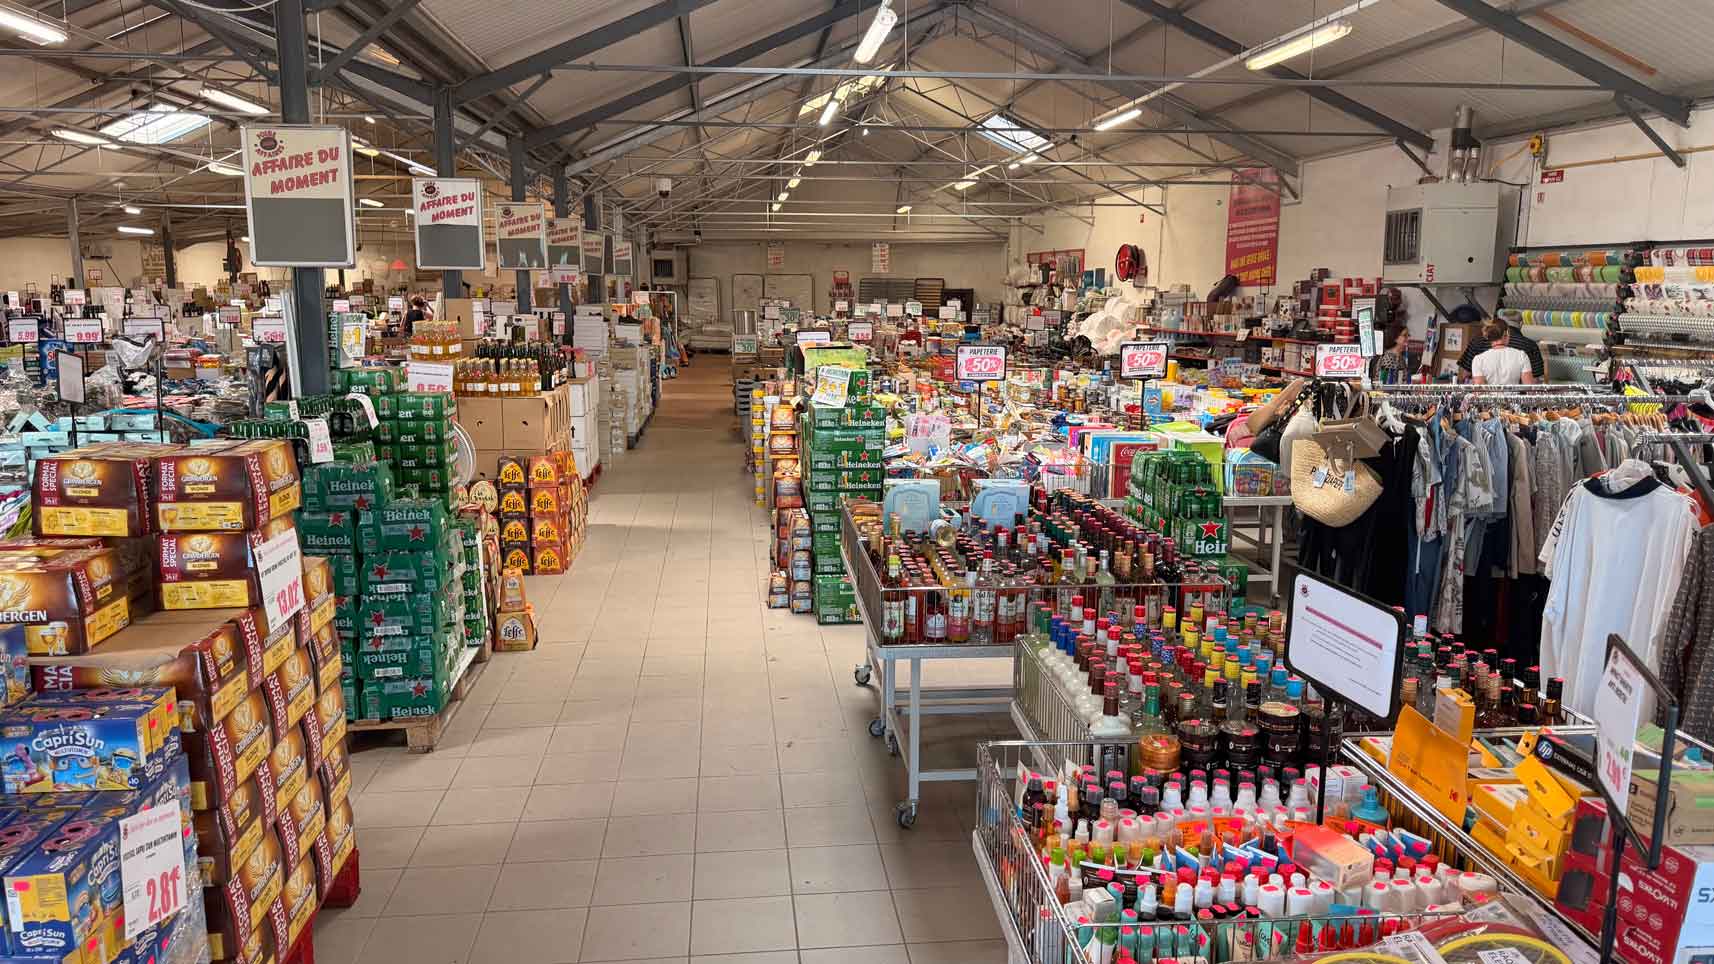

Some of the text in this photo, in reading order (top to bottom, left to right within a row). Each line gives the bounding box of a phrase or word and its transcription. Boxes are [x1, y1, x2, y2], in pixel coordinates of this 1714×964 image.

[252, 147, 339, 176] AFFAIRE DU
[271, 169, 338, 194] MOMENT
[420, 192, 475, 212] AFFAIRE DU
[432, 206, 474, 222] MOMENT
[500, 216, 529, 229] AFFAIRE
[1425, 264, 1436, 283] CIAT
[504, 466, 521, 480] Leffe
[535, 466, 553, 480] Leffe
[330, 480, 375, 491] Heinek
[505, 497, 521, 511] Leffe
[537, 497, 553, 511] Leffe
[384, 510, 431, 521] Heinek
[307, 535, 352, 545] Heinek
[507, 526, 523, 540] Leffe
[539, 527, 555, 540] Leffe
[510, 555, 527, 569] Leffe
[541, 554, 557, 569] Leffe
[503, 625, 523, 640] Leffe
[392, 705, 435, 718] Heinek
[1537, 741, 1553, 758] hp
